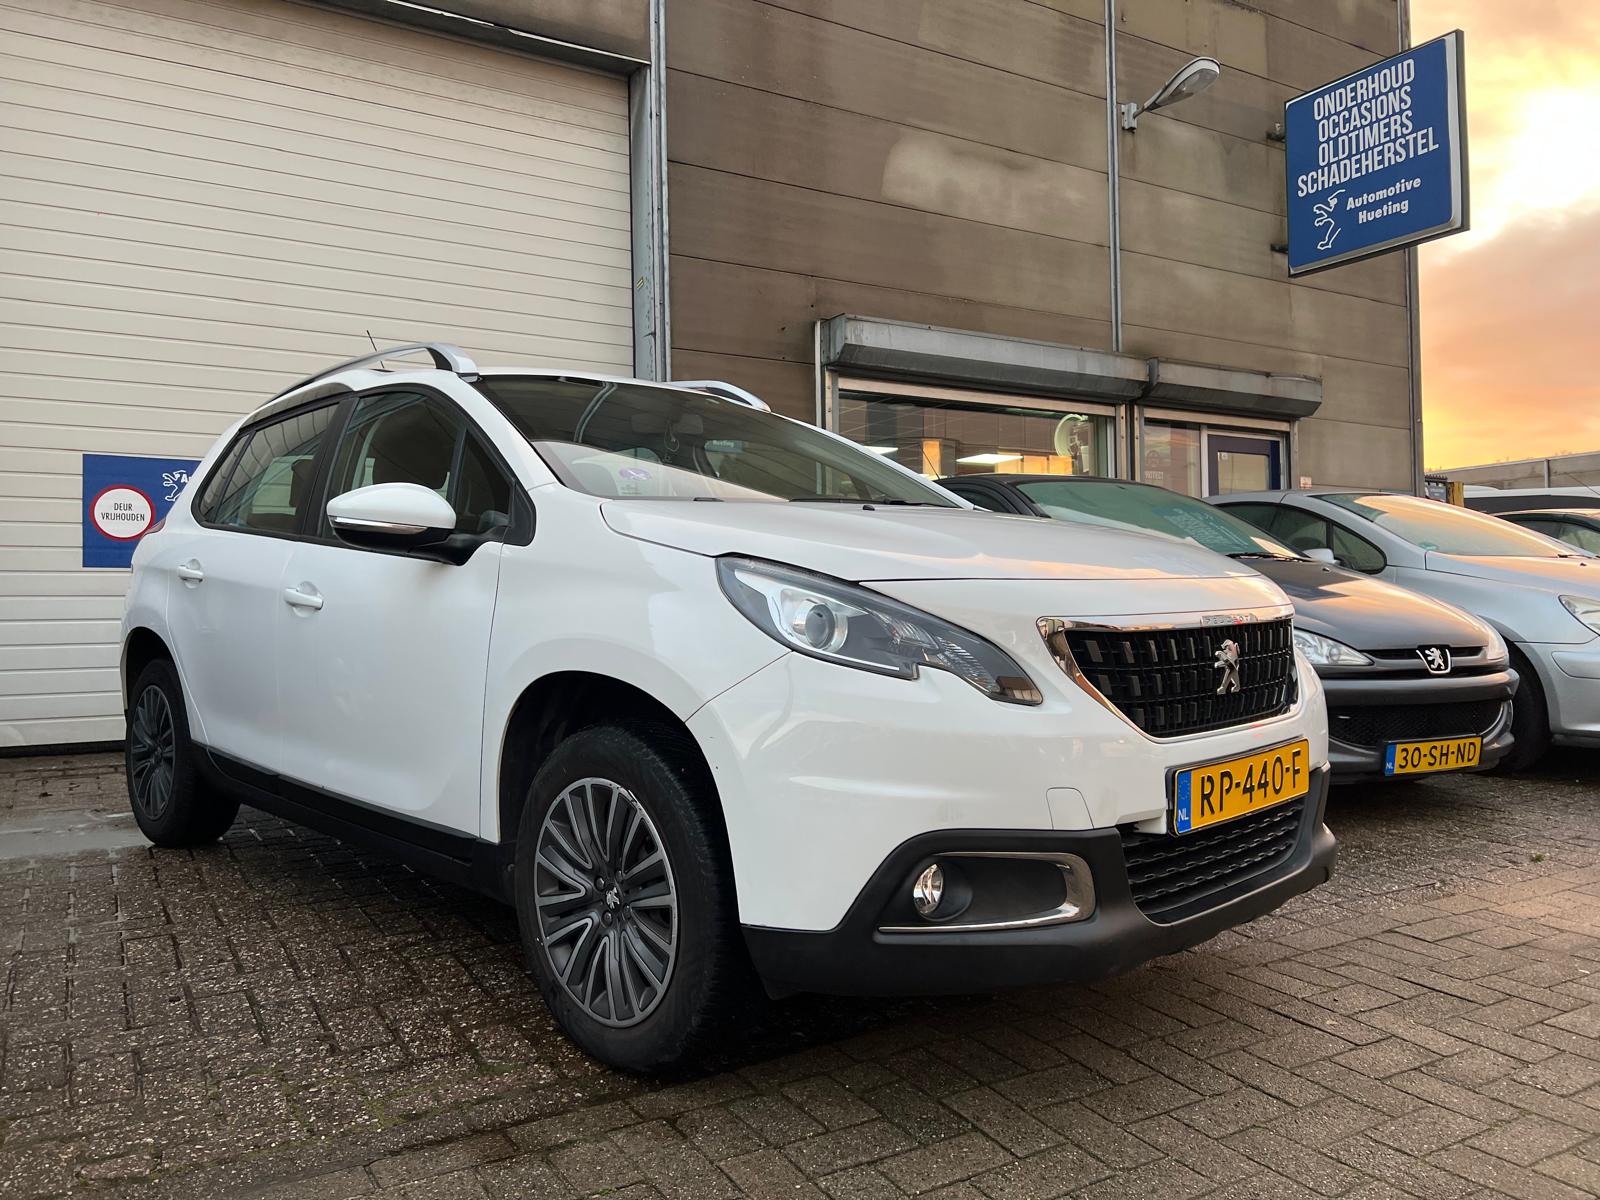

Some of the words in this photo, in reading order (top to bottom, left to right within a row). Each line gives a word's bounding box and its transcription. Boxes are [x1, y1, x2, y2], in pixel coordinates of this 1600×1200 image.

[1313, 58, 1415, 121] ONDERHOUD
[1318, 85, 1412, 143] OCCASIONS
[1318, 111, 1413, 167] OLDTIMERS
[1297, 126, 1439, 198] SCHADEHERSTEL
[1346, 176, 1421, 211] Automotive
[1358, 199, 1409, 224] Hueting
[101, 512, 145, 522] VRIJHOUDEN
[113, 502, 133, 511] DEUR
[1398, 741, 1477, 770] 30-SH-ND
[1178, 808, 1189, 823] NL
[1200, 749, 1302, 818] RP-440-F
